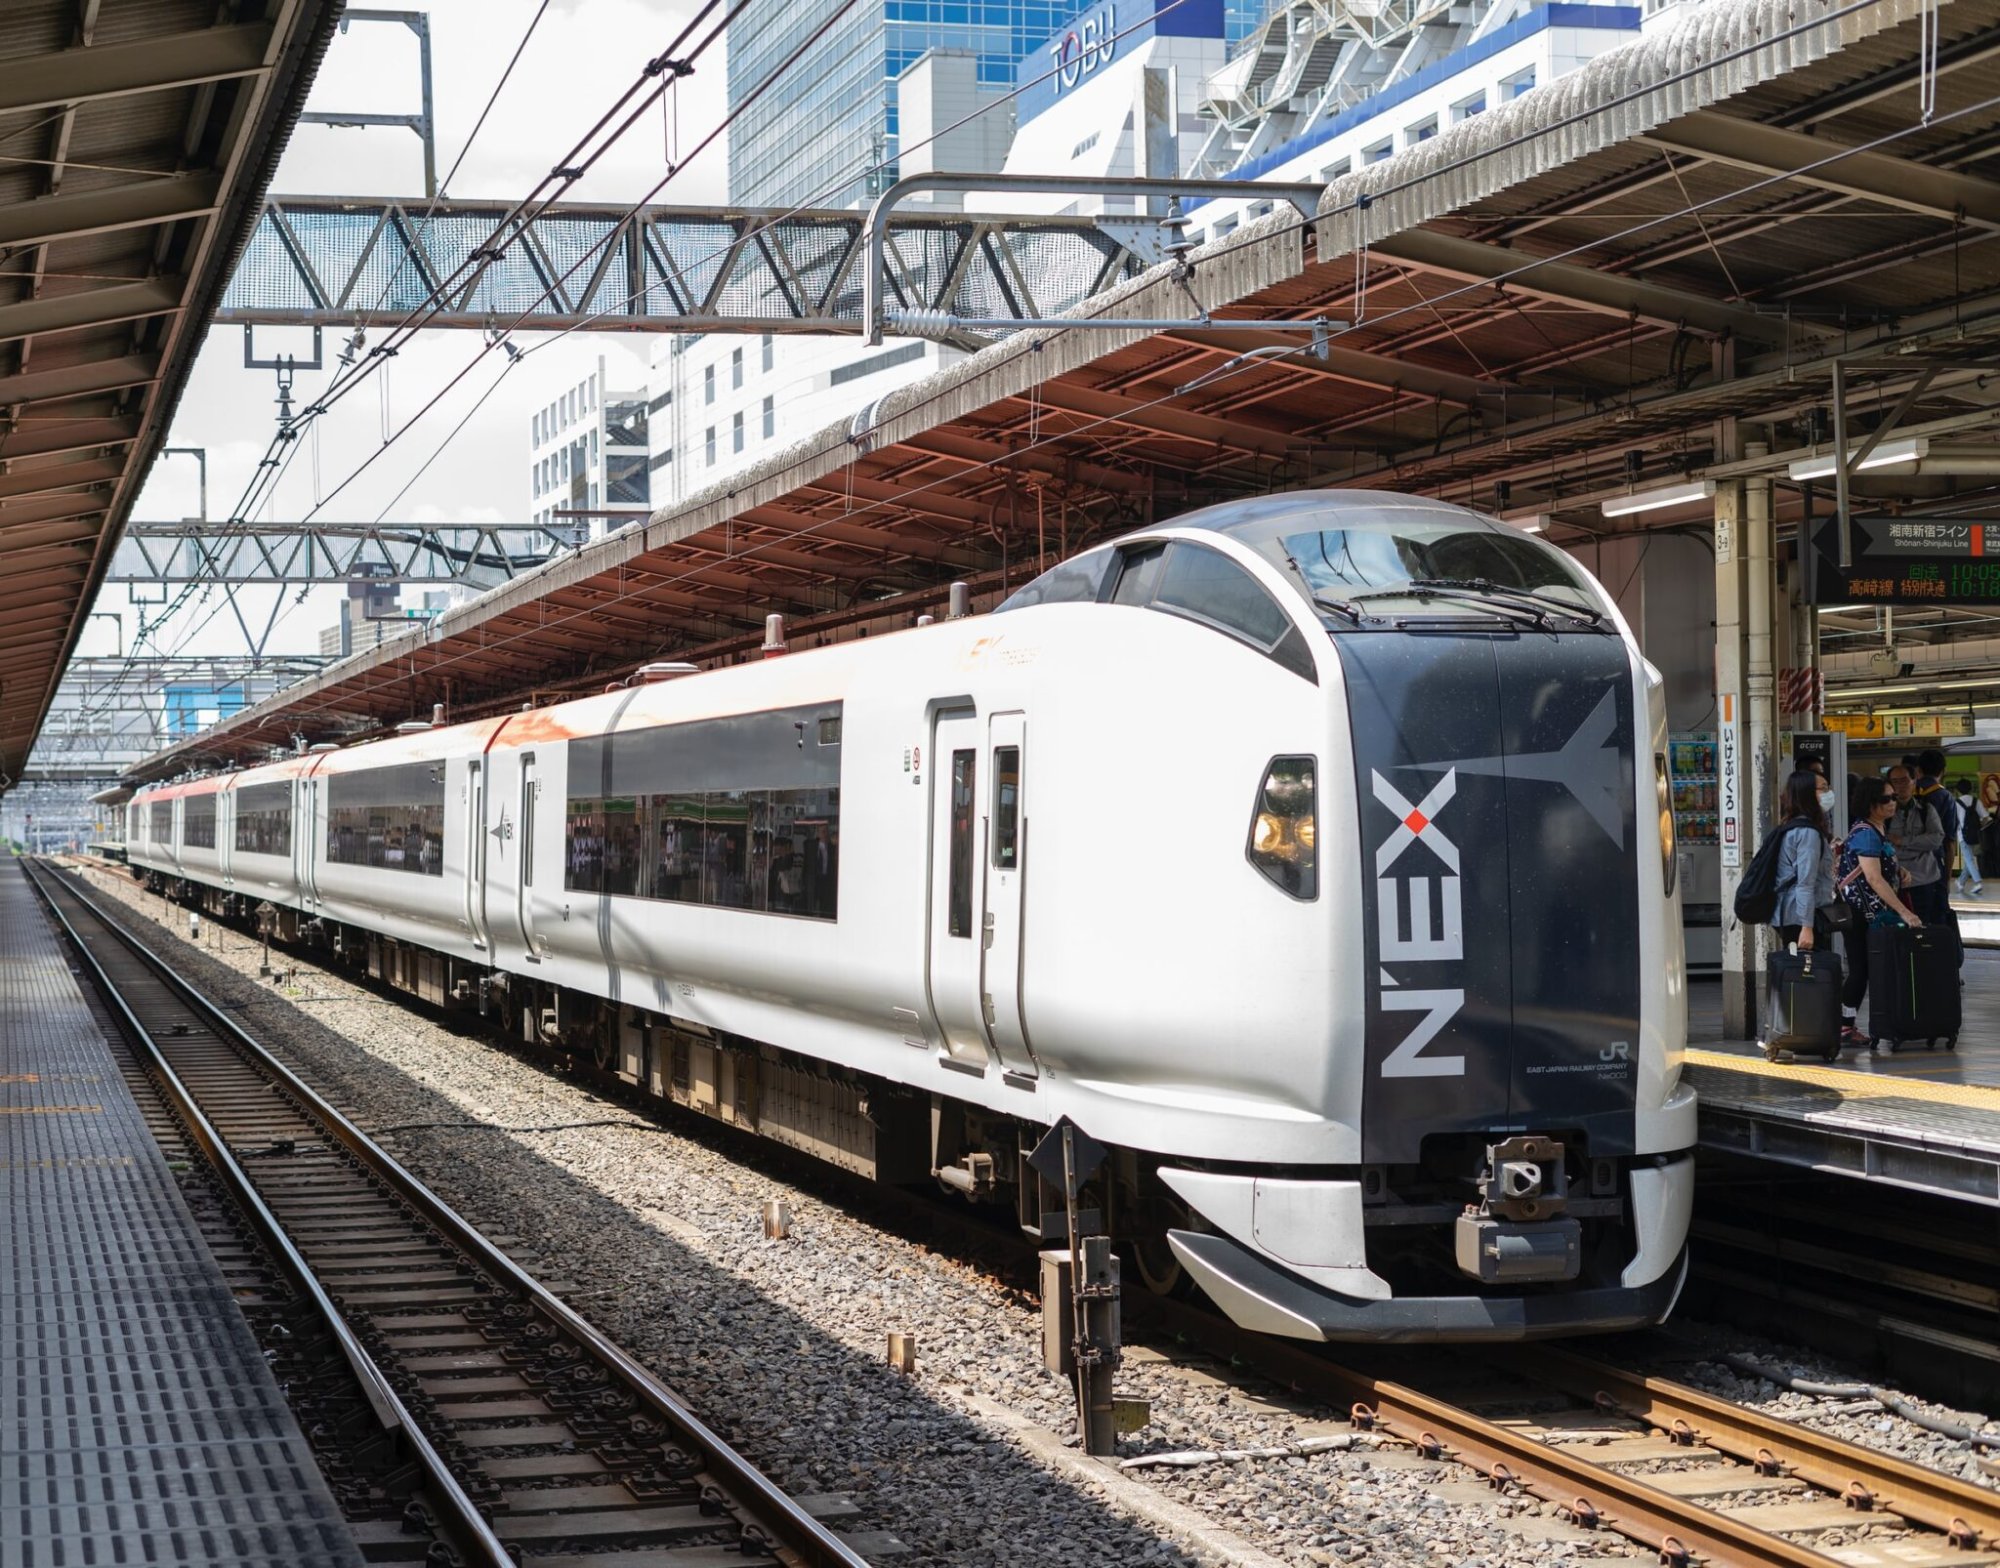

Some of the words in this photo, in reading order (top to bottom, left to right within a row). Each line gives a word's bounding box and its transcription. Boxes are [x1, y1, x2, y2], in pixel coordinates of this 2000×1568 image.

[1051, 4, 1115, 94] TOBU
[1889, 524, 1968, 537] 湘南新宿ライン
[1909, 564, 1939, 579] 回送
[1849, 580, 1893, 596] 高崎線
[1901, 580, 1946, 597] 特別快速
[1799, 742, 1825, 750] acure
[1724, 728, 1735, 812] いけぶくろ
[1600, 1041, 1629, 1061] JR
[1545, 1065, 1568, 1073] JAPAN
